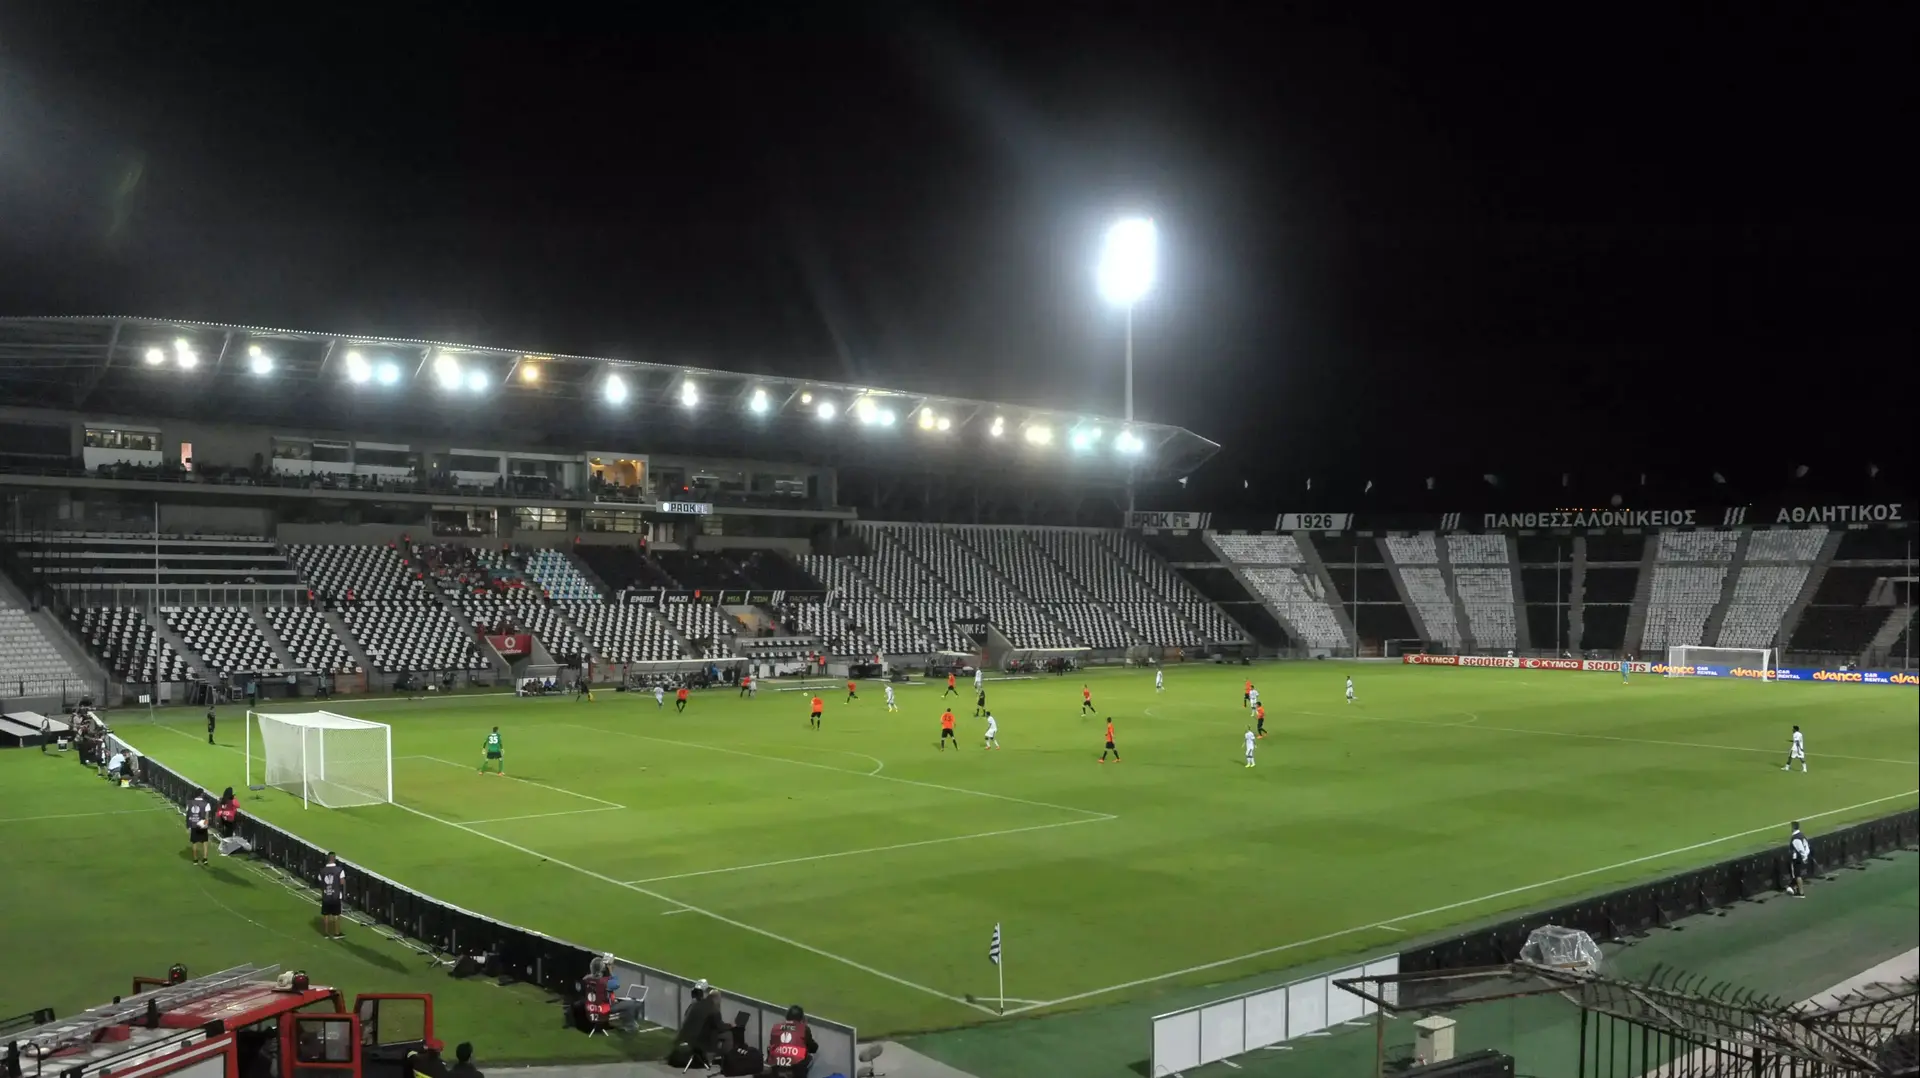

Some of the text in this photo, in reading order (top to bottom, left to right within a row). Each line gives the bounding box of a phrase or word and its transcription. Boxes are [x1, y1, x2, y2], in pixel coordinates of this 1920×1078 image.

[670, 503, 695, 512] PAOK
[1132, 513, 1169, 527] PAOK
[1296, 514, 1332, 528] 1926
[1484, 504, 1902, 528] ΠΑΝΘΕΣΣΑΛΟΝΙΚΕΙΟΣ ΑΘΛΗΤΙΚΟΣ
[1423, 656, 1456, 664] KYMCO
[1463, 657, 1515, 667] scooters
[1541, 660, 1579, 669] KYMCO
[488, 735, 498, 744] 35
[776, 1057, 792, 1067] 102
